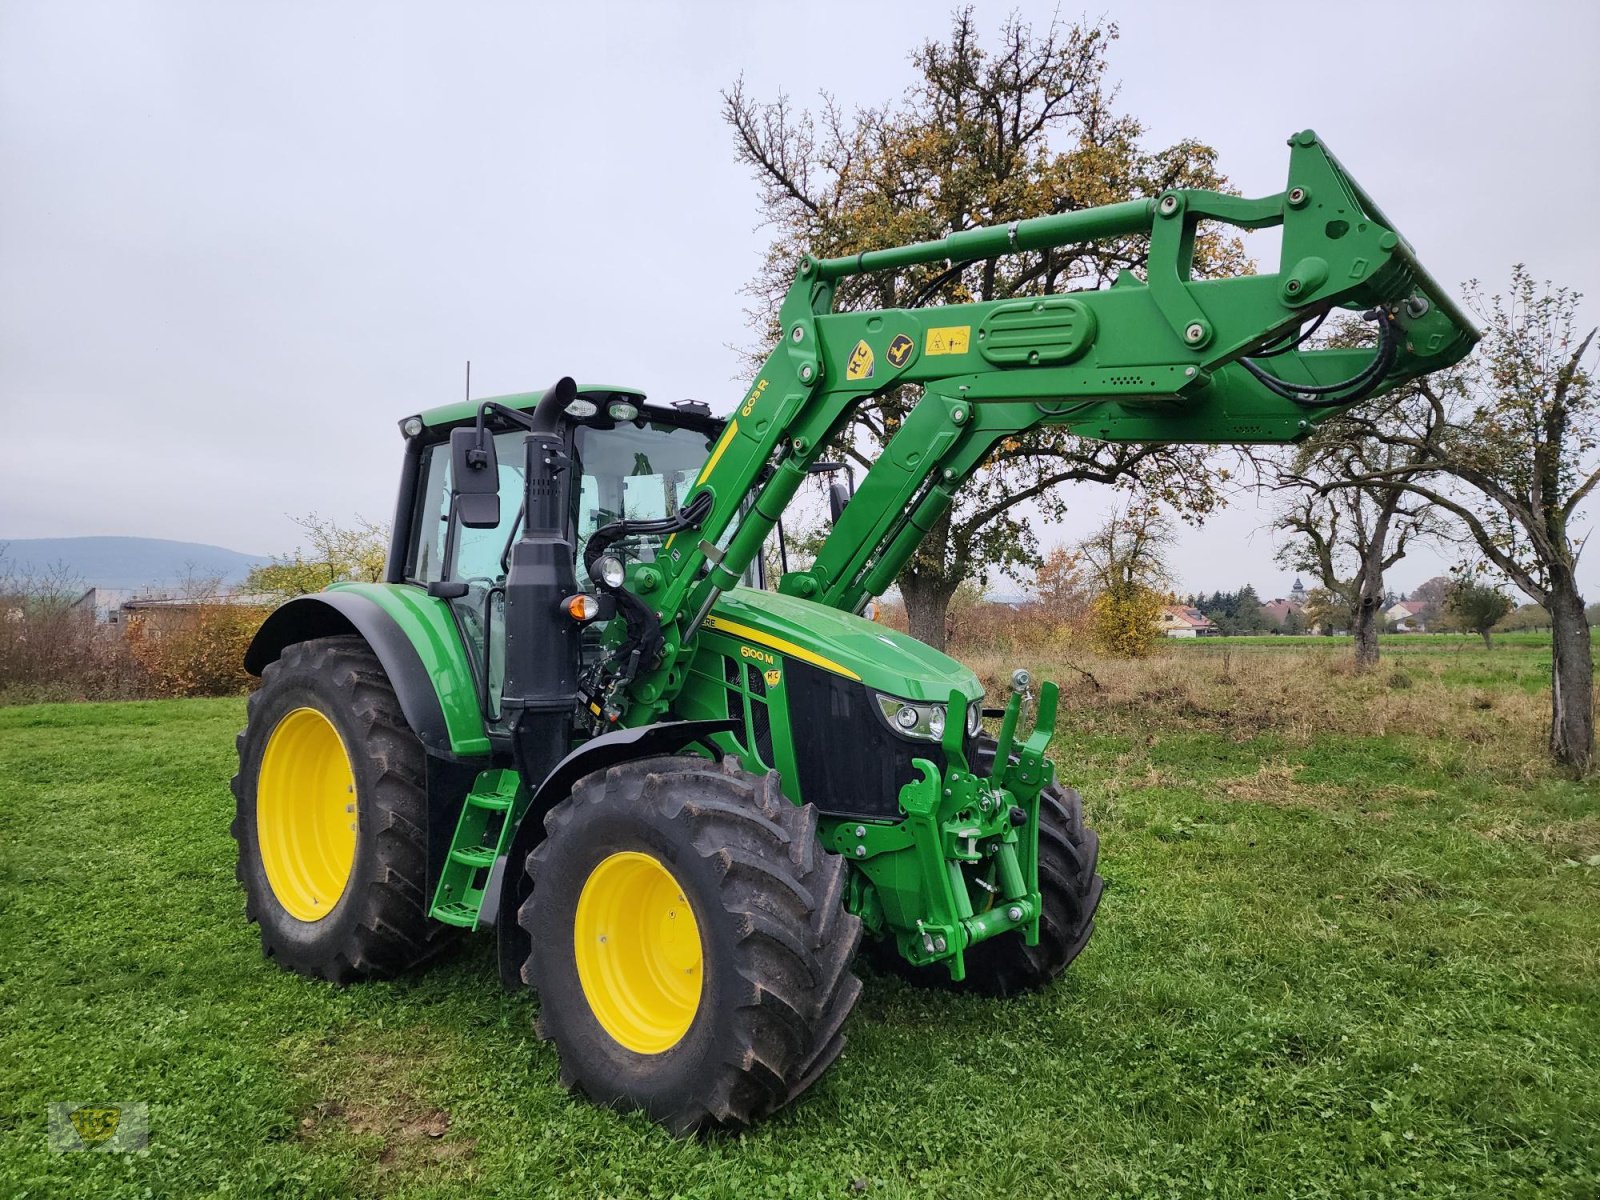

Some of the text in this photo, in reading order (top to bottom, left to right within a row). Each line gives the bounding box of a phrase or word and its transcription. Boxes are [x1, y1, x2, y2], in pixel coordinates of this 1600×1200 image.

[742, 379, 769, 417] 603 R
[741, 646, 774, 665] 6100 M
